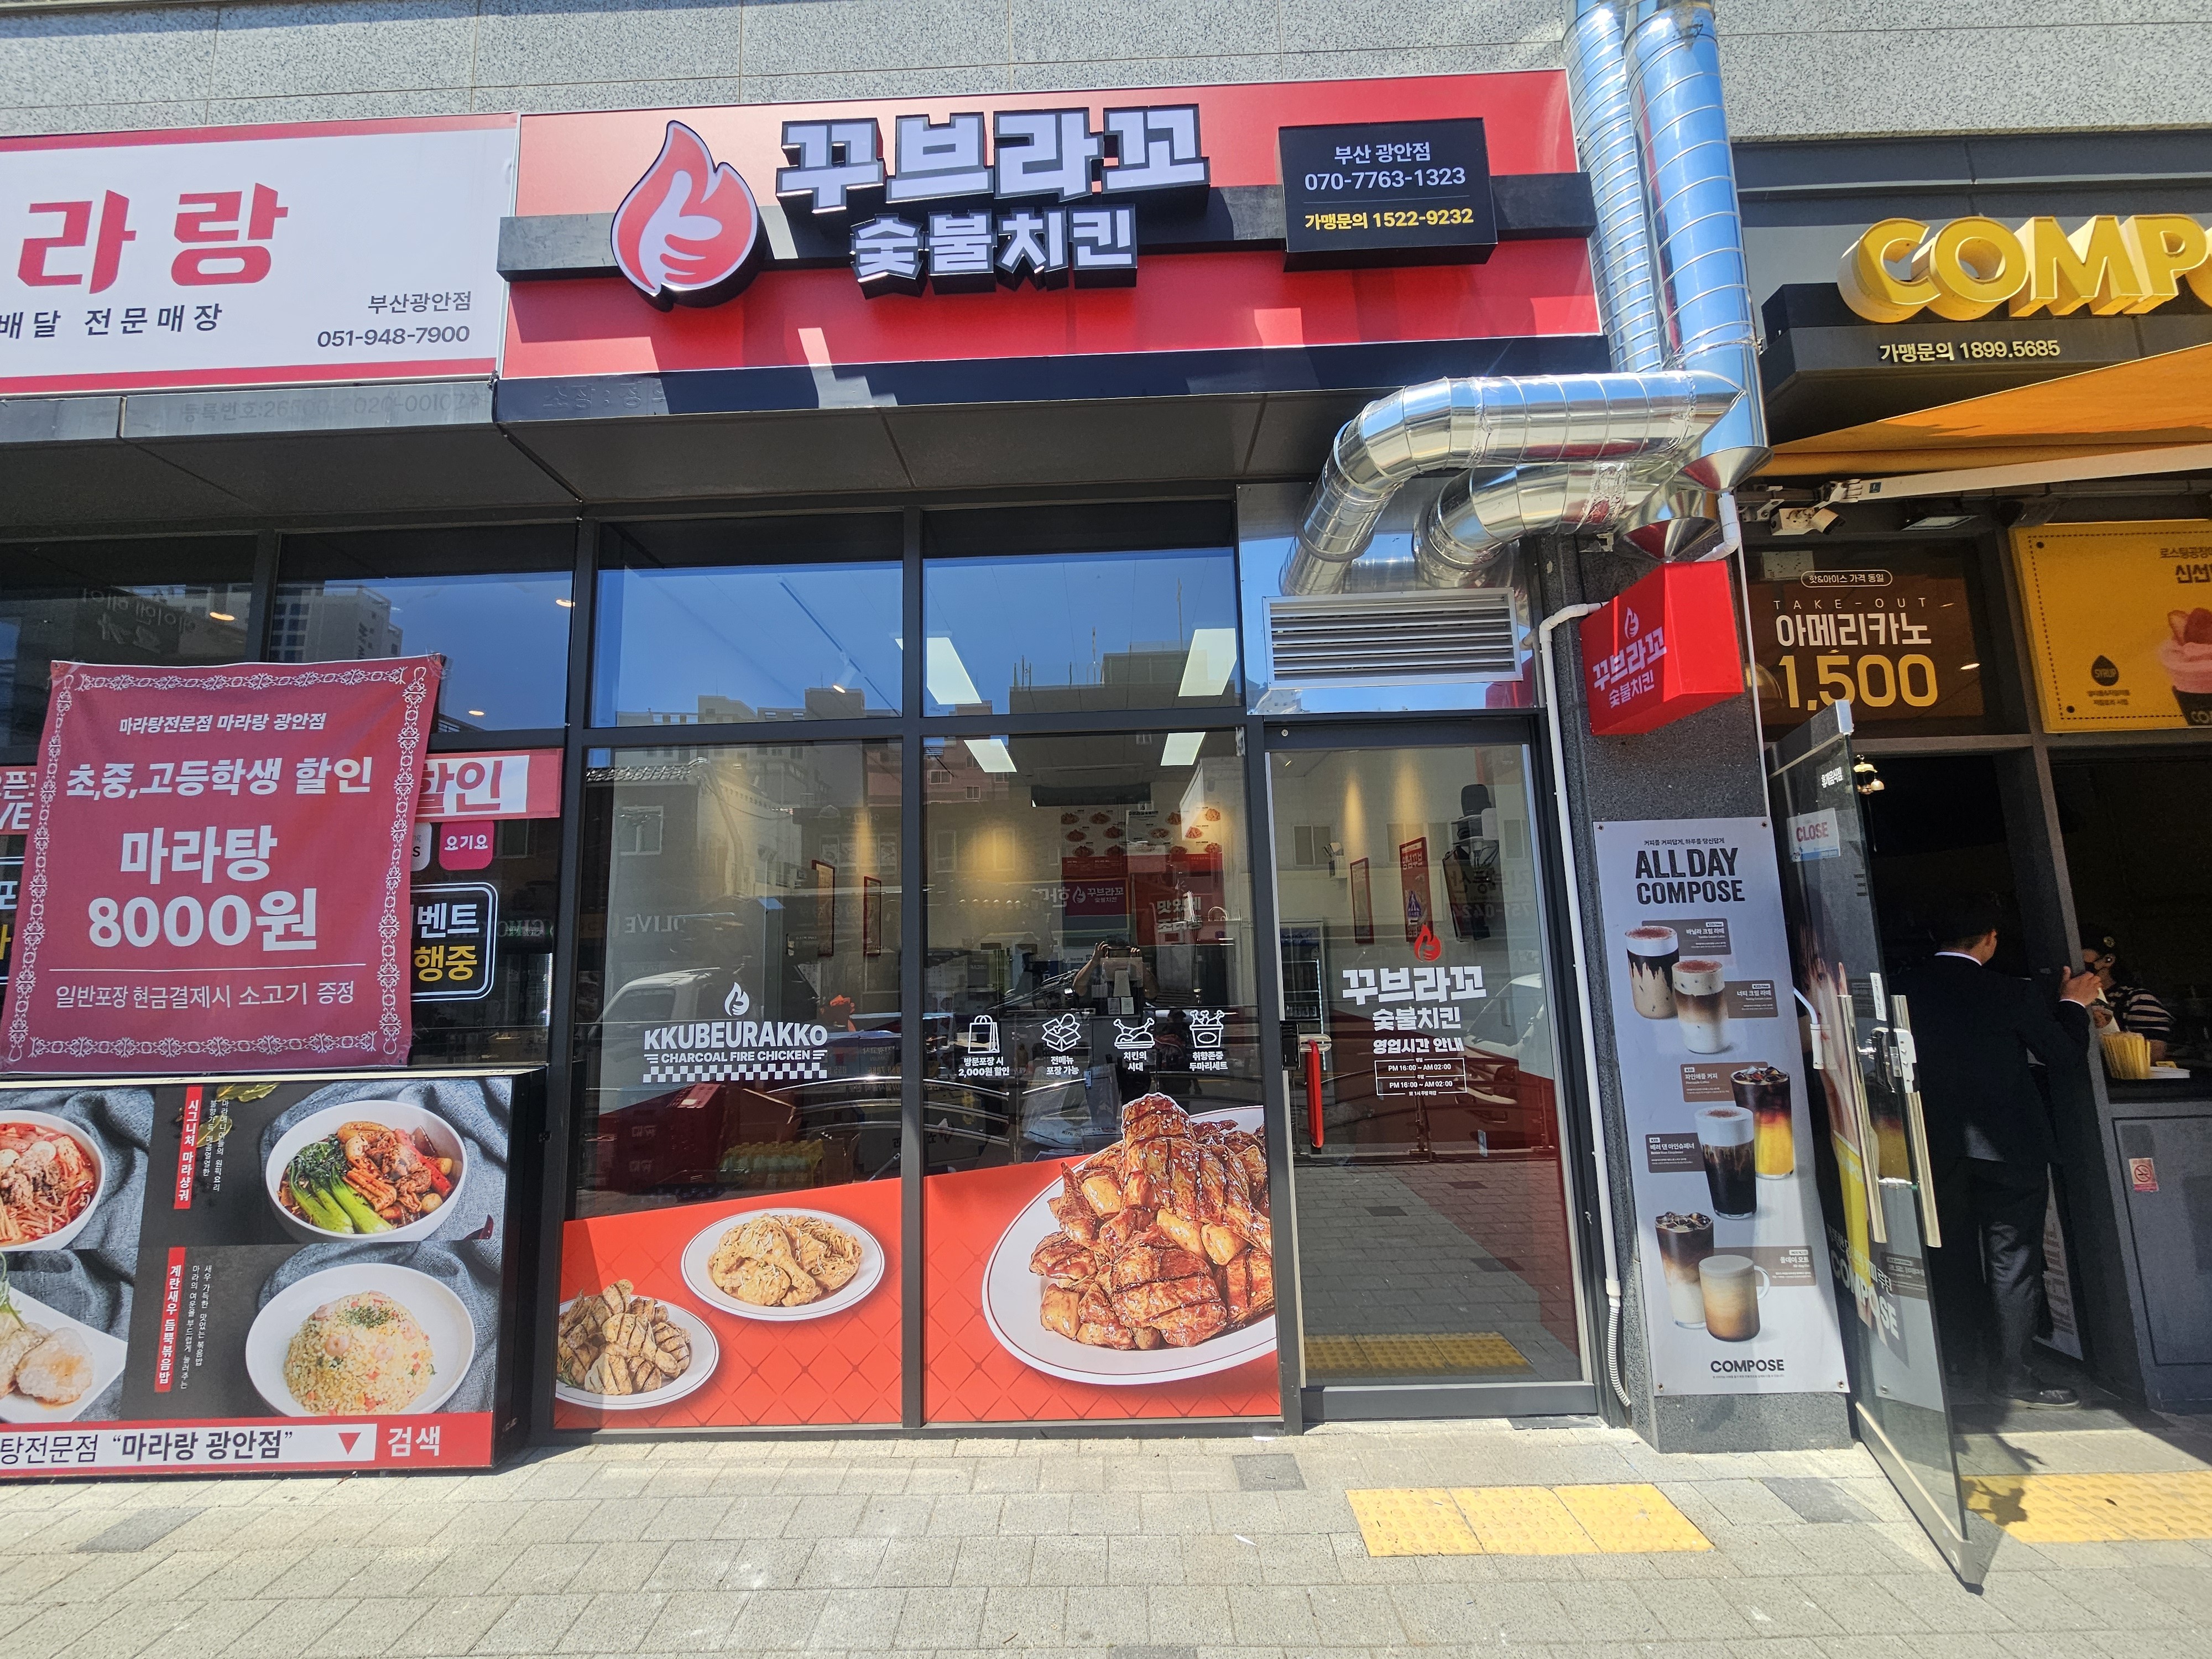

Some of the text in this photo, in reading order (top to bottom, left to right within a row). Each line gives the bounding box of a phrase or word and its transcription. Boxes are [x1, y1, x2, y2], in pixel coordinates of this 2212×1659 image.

[778, 106, 1209, 212] 꾸브라꼬
[1334, 142, 1431, 165] 부산 광안점
[1305, 167, 1465, 191] 070-7763-1323
[1305, 208, 1474, 230] 가맹문의 1522-9232
[852, 206, 1136, 279] 숯불치킨
[1837, 213, 2212, 322] COMP
[367, 291, 472, 314] 부산광안점
[0, 302, 222, 339] 배달 전문매장
[317, 326, 469, 348] 051-948-7900
[1880, 340, 2060, 363] 가맹문의 1899.5685
[1809, 573, 1885, 583] 핫&아이스 가격 동일
[2176, 564, 2212, 583] 신선
[1776, 613, 1931, 646] 아메리카노
[1593, 626, 1667, 691] 꾸브라꼬
[1609, 670, 1655, 708] 숯불치킨
[119, 713, 327, 735] 마라탕전문점 마라랑 광안점
[66, 756, 372, 800] 초,중,고등학생 할인
[1821, 766, 1844, 788] 휴게음식점
[444, 834, 488, 851] 요기요
[1796, 822, 1829, 842] CLOSE
[121, 825, 277, 884] 마라탕
[1635, 848, 1738, 879] ALL DAY
[1636, 880, 1745, 905] COMPOSE
[88, 889, 317, 951] 8000원
[56, 981, 354, 1009] 일반포장 현금결제시 소고기 증정
[1342, 966, 1487, 1005] 꾸브라꼬
[1373, 1006, 1462, 1031] 숯불치킨
[644, 1021, 828, 1050] KKUBEURAKKO
[1373, 1037, 1465, 1055] 영업시간 안내
[661, 1050, 810, 1063] CHARCOAL FIRE CHICKEN
[964, 1057, 1004, 1067] 방문포장 시
[1051, 1056, 1074, 1065] 전메뉴
[1124, 1051, 1147, 1061] 치킨의
[1128, 1062, 1144, 1072] 시대
[1189, 1061, 1228, 1071] 두마리세트
[1192, 1051, 1224, 1061] 취향존중
[958, 1067, 1010, 1078] 2,000원 할인
[1046, 1066, 1079, 1075] 포장 가능
[178, 1099, 199, 1201] 시그니처 마라샹궈
[204, 1265, 212, 1281] 새우
[1830, 1250, 1900, 1340] COMPOSE
[159, 1265, 181, 1384] 계란새우 듬뿍볶음밥
[1710, 1359, 1785, 1373] COMPOSE
[0, 1434, 98, 1465] 탕전문점
[387, 1426, 441, 1457] 검색
